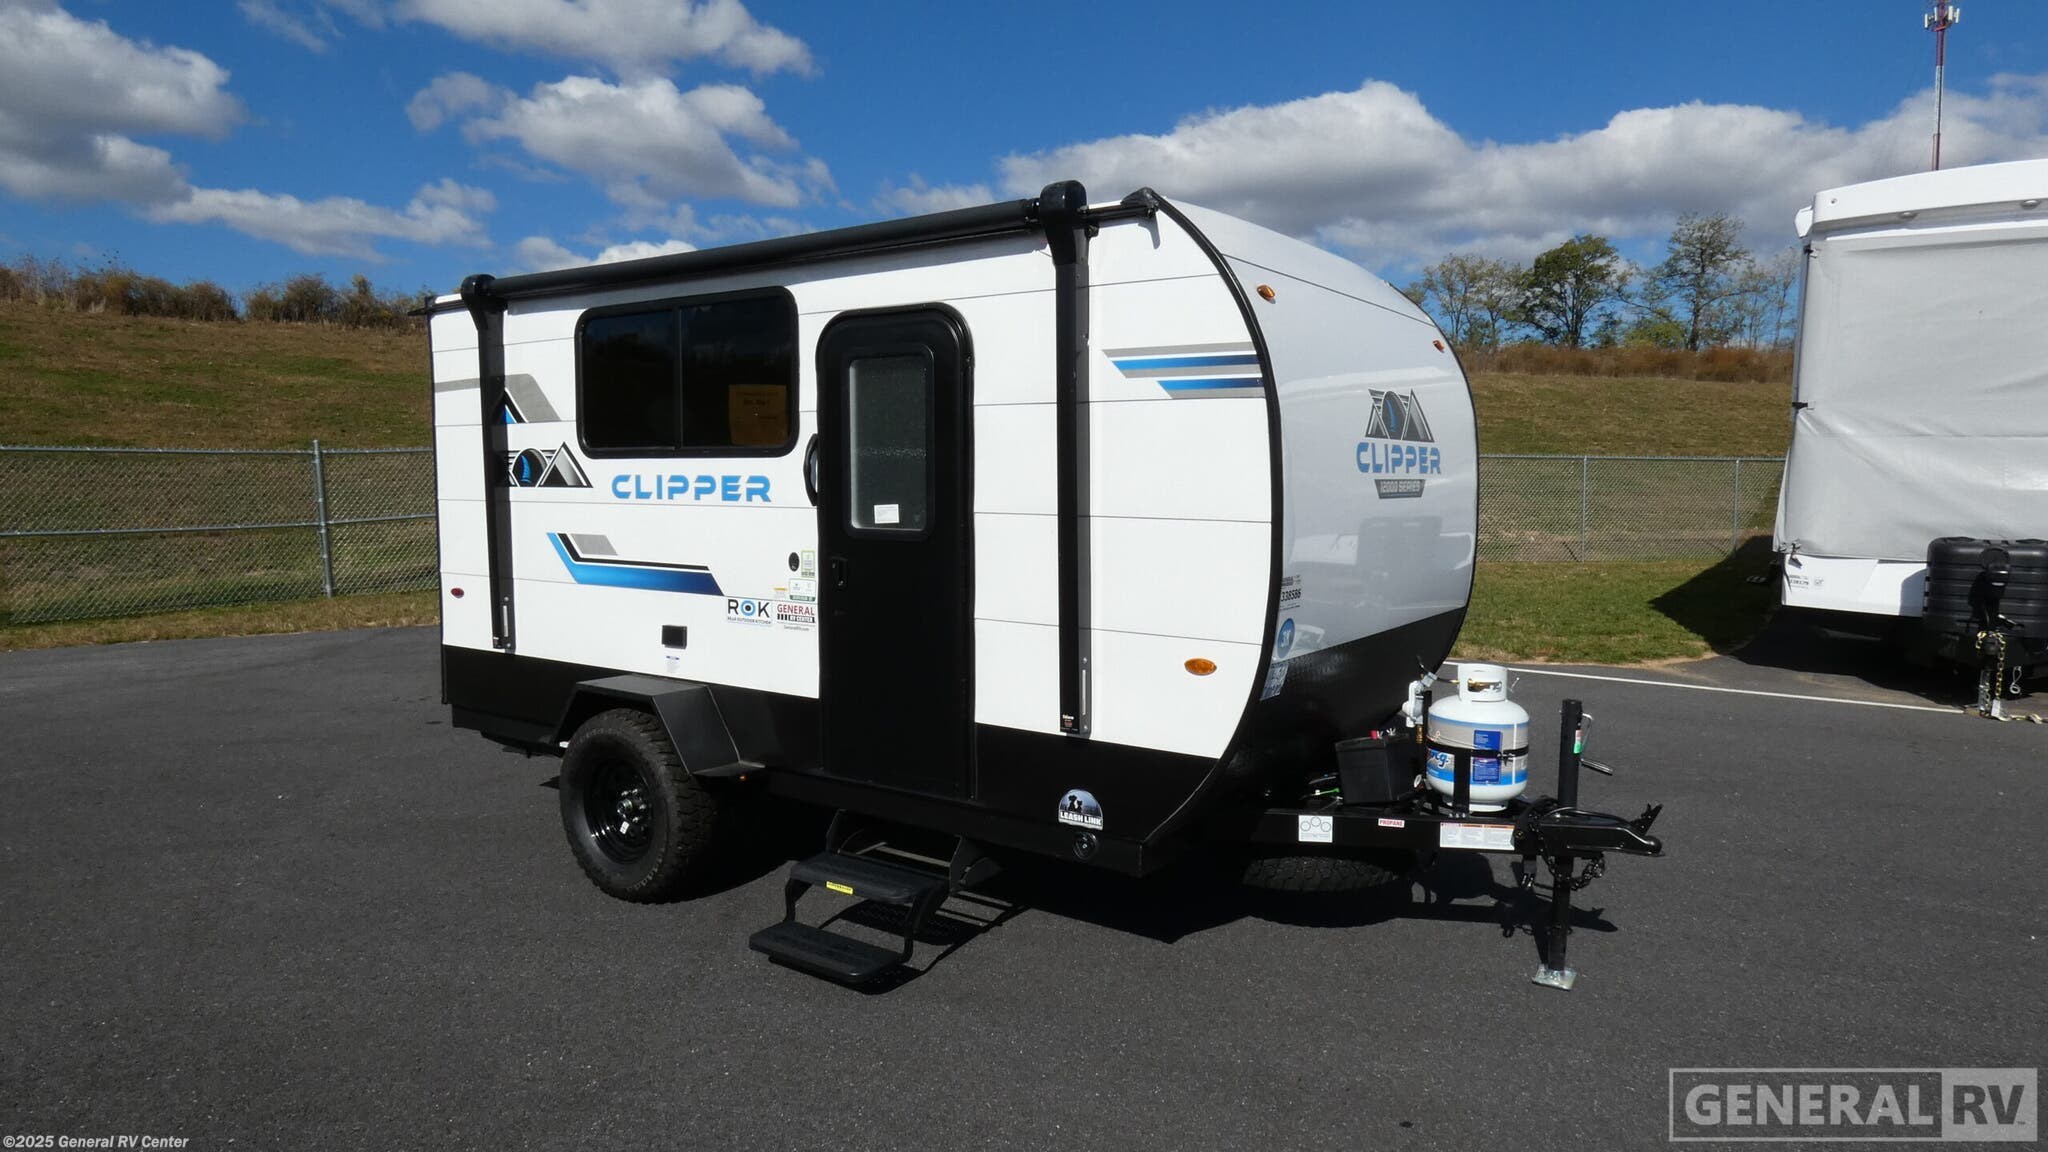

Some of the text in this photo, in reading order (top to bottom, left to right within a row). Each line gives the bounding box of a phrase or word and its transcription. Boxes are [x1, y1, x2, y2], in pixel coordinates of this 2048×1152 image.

[1356, 442, 1441, 474] CLIPPER
[611, 474, 771, 502] CLIPPER
[1399, 480, 1420, 492] SERIES
[727, 599, 770, 618] ROK
[777, 604, 814, 616] GENERAL
[1060, 811, 1101, 826] LEASH LINK
[1380, 819, 1403, 827] PROPANE
